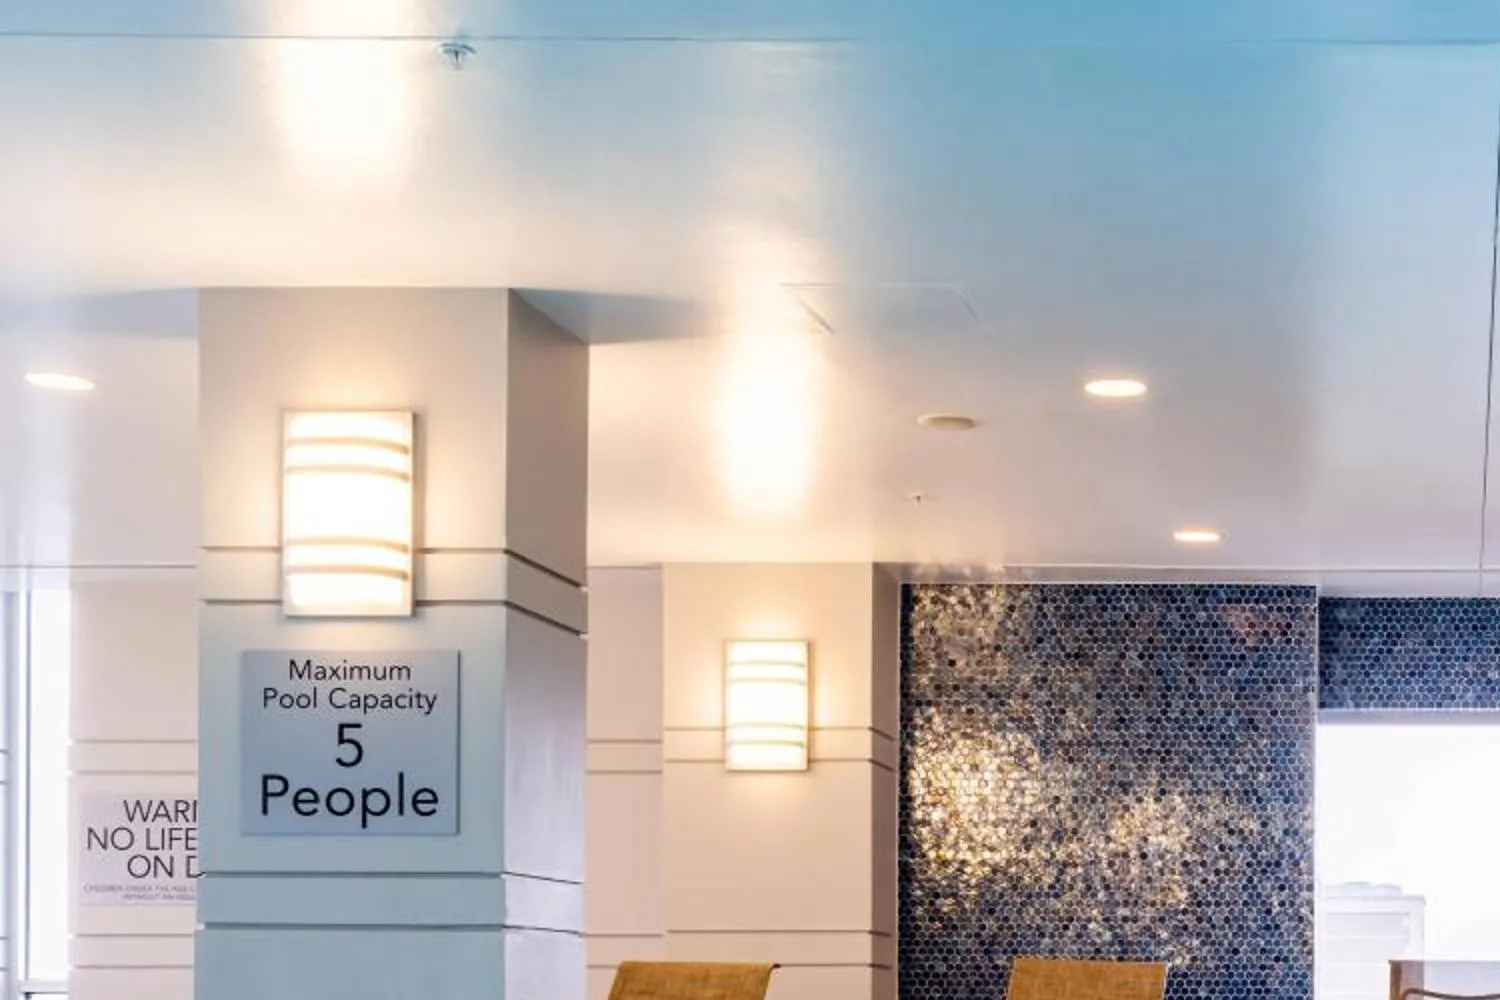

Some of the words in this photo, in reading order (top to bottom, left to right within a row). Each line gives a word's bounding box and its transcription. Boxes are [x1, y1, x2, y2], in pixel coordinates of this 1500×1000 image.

[289, 659, 411, 680] Maximum
[263, 686, 317, 709] Pool
[328, 687, 437, 715] Capacity
[335, 723, 364, 768] 5
[123, 799, 198, 823] WAR
[262, 772, 439, 829] People
[87, 827, 135, 851] NO
[127, 854, 174, 879] ON
